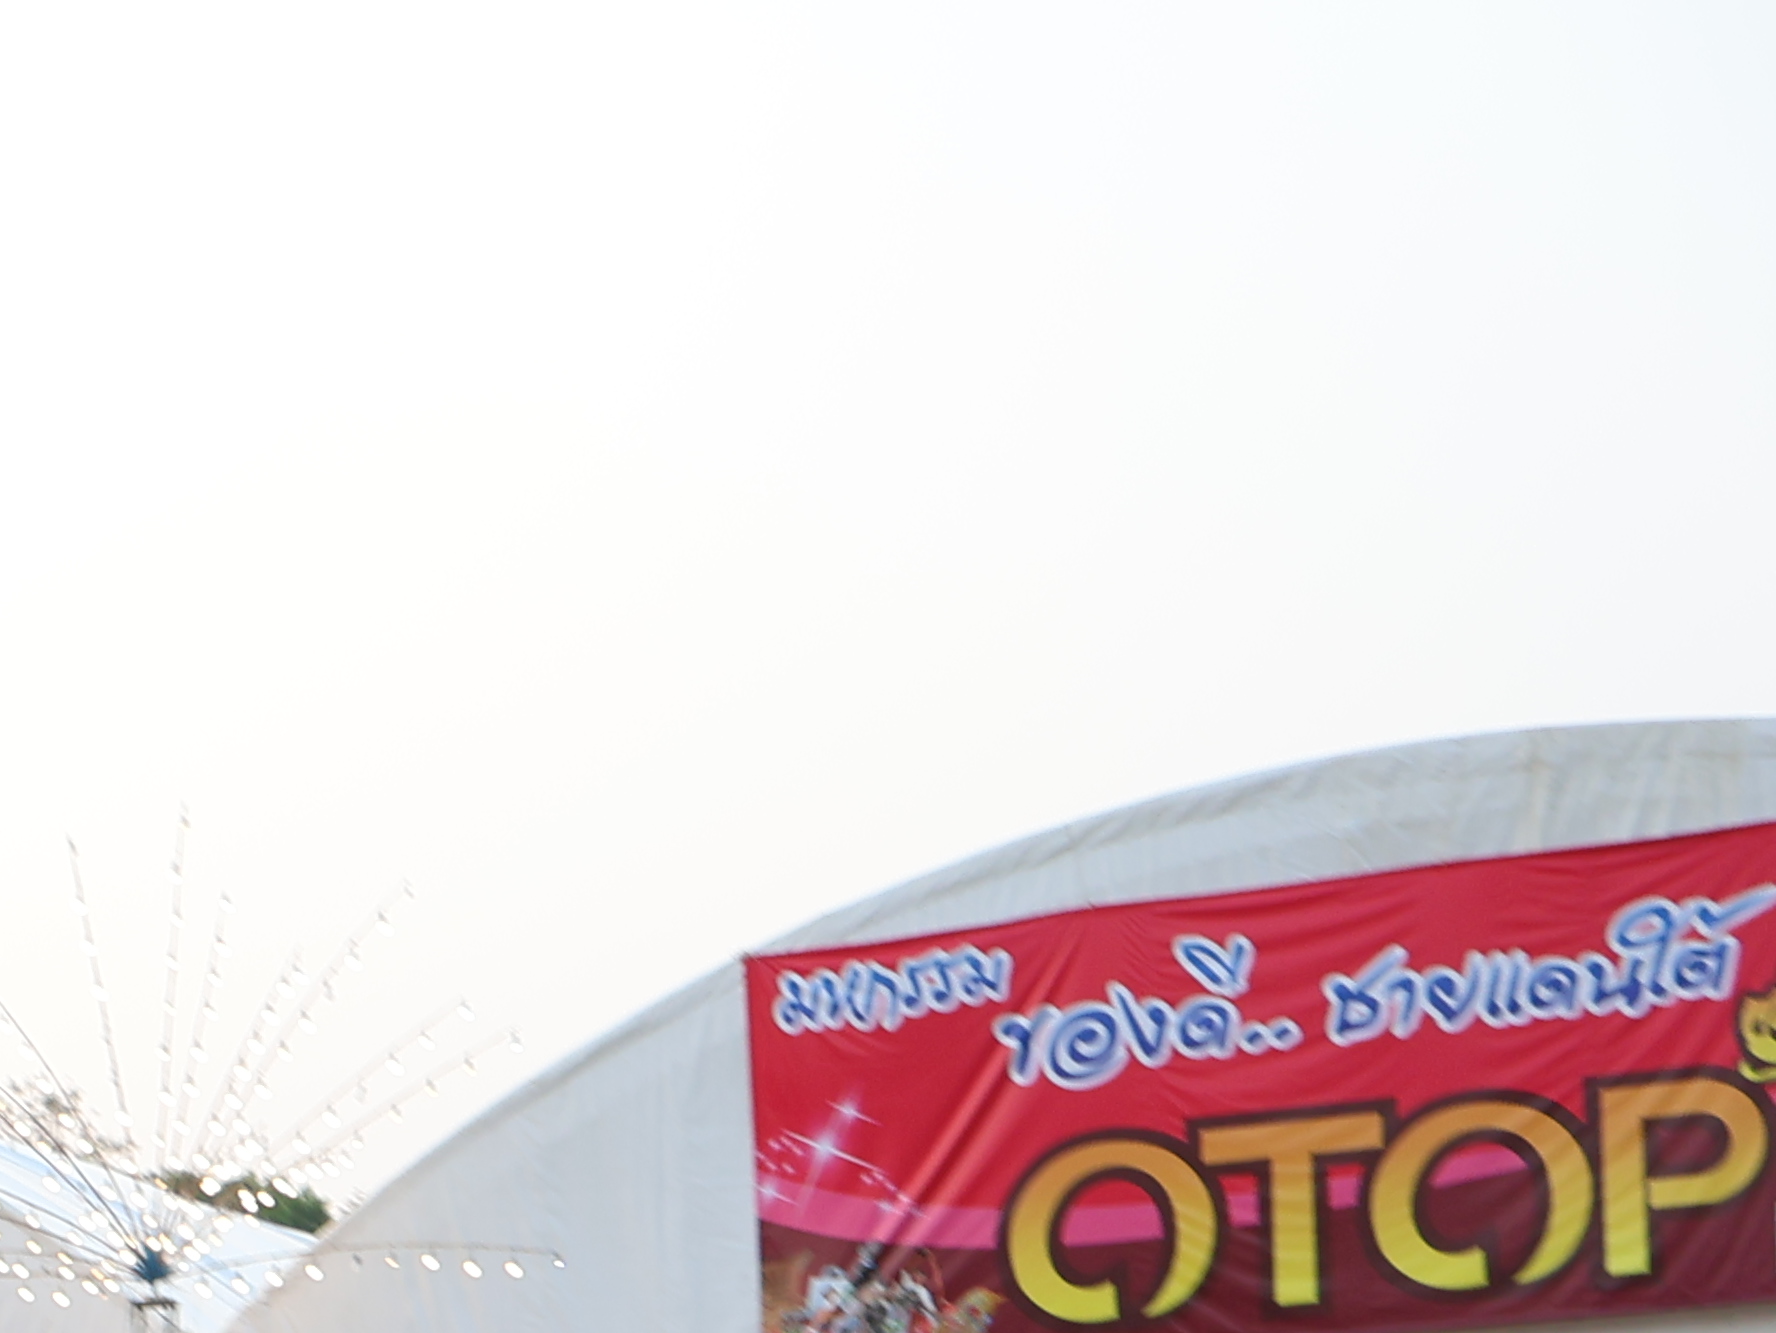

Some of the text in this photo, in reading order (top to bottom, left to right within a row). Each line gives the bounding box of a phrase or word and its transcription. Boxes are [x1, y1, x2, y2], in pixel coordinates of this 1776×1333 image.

[773, 943, 1014, 1036] มหกรรม
[1320, 883, 1776, 1047] ชายแดนใต้
[1001, 1072, 1774, 1328] OTOP
